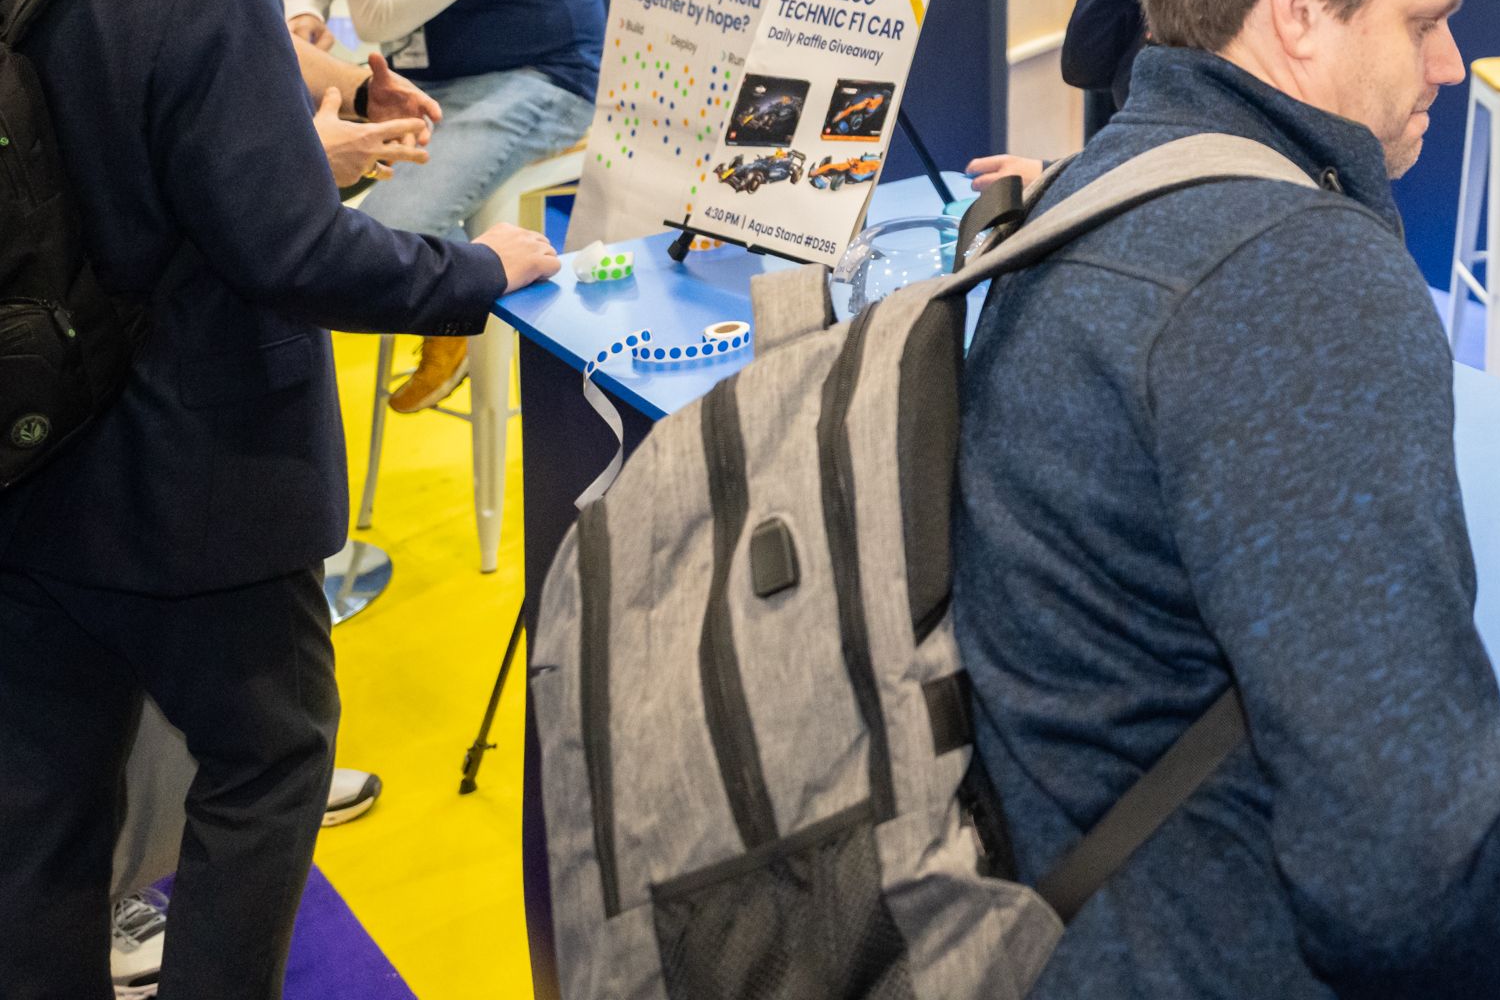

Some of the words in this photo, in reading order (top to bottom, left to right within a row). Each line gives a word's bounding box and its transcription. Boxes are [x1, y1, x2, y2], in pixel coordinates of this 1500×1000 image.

[625, 20, 645, 36] Build
[705, 5, 751, 33] hope?
[849, 12, 866, 35] F1
[866, 14, 905, 41] CAR
[670, 33, 698, 55] Deploy
[767, 26, 796, 49] Daily
[797, 32, 826, 52] Raffle
[827, 39, 884, 66] Giveaway
[704, 205, 724, 222] 4:30
[724, 211, 740, 226] PM
[747, 219, 774, 238] Aqua
[775, 227, 803, 245] Stand
[804, 233, 837, 256] #D295
